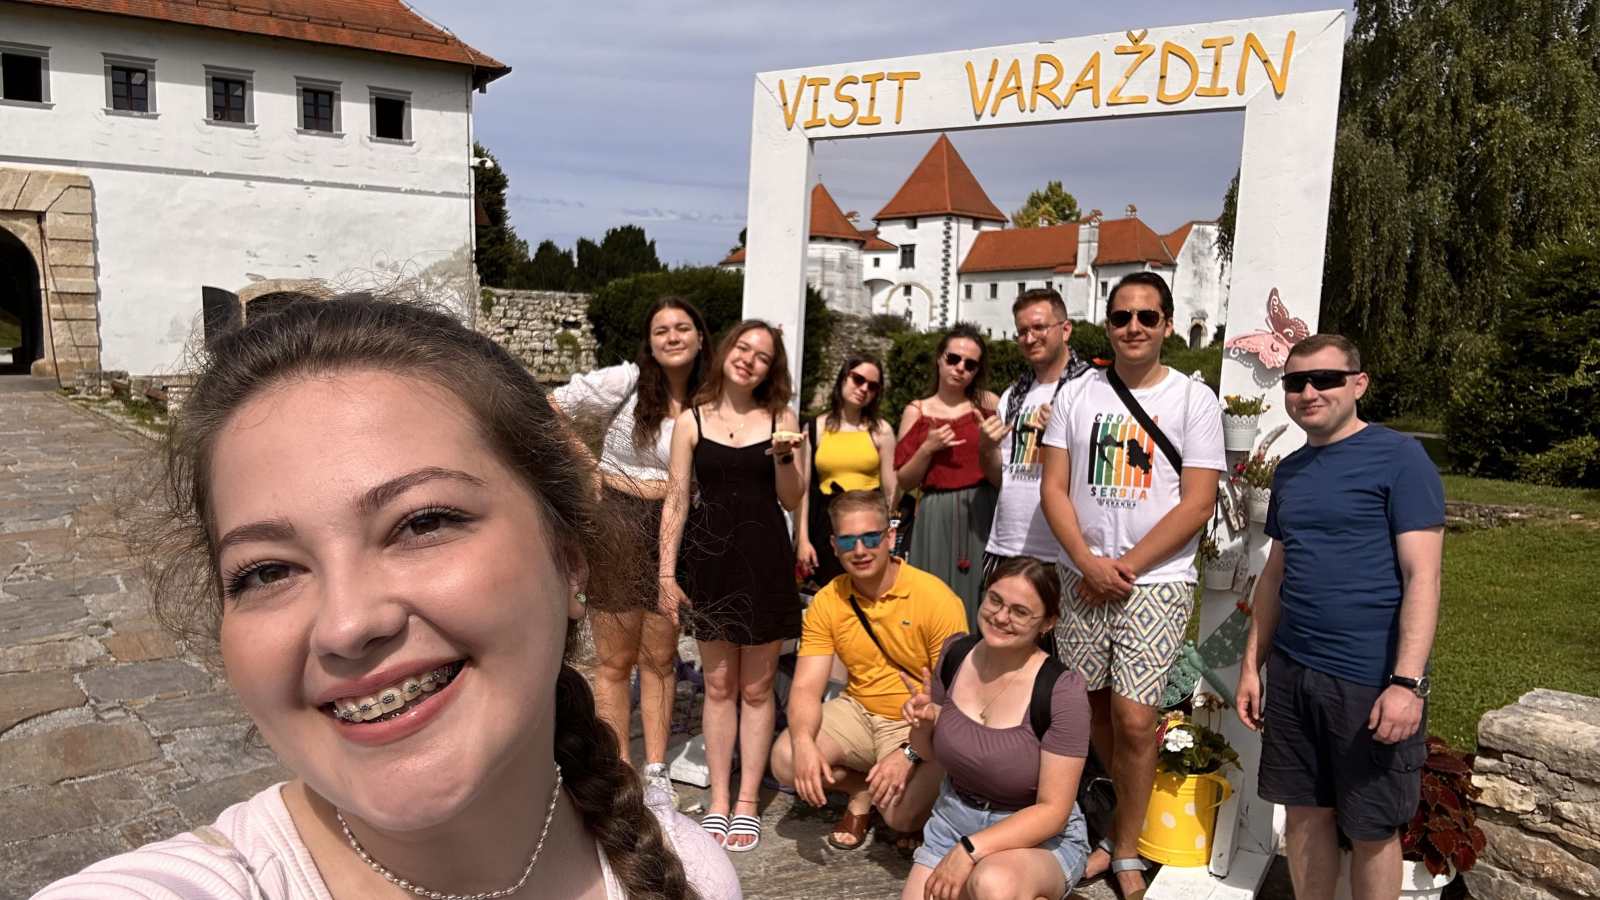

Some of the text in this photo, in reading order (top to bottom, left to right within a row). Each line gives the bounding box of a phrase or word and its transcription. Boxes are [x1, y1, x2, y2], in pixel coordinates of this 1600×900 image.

[778, 28, 1297, 131] VISIT VARAŽDIN
[1094, 413, 1159, 424] CROAA
[1090, 486, 1148, 500] SERBIA
